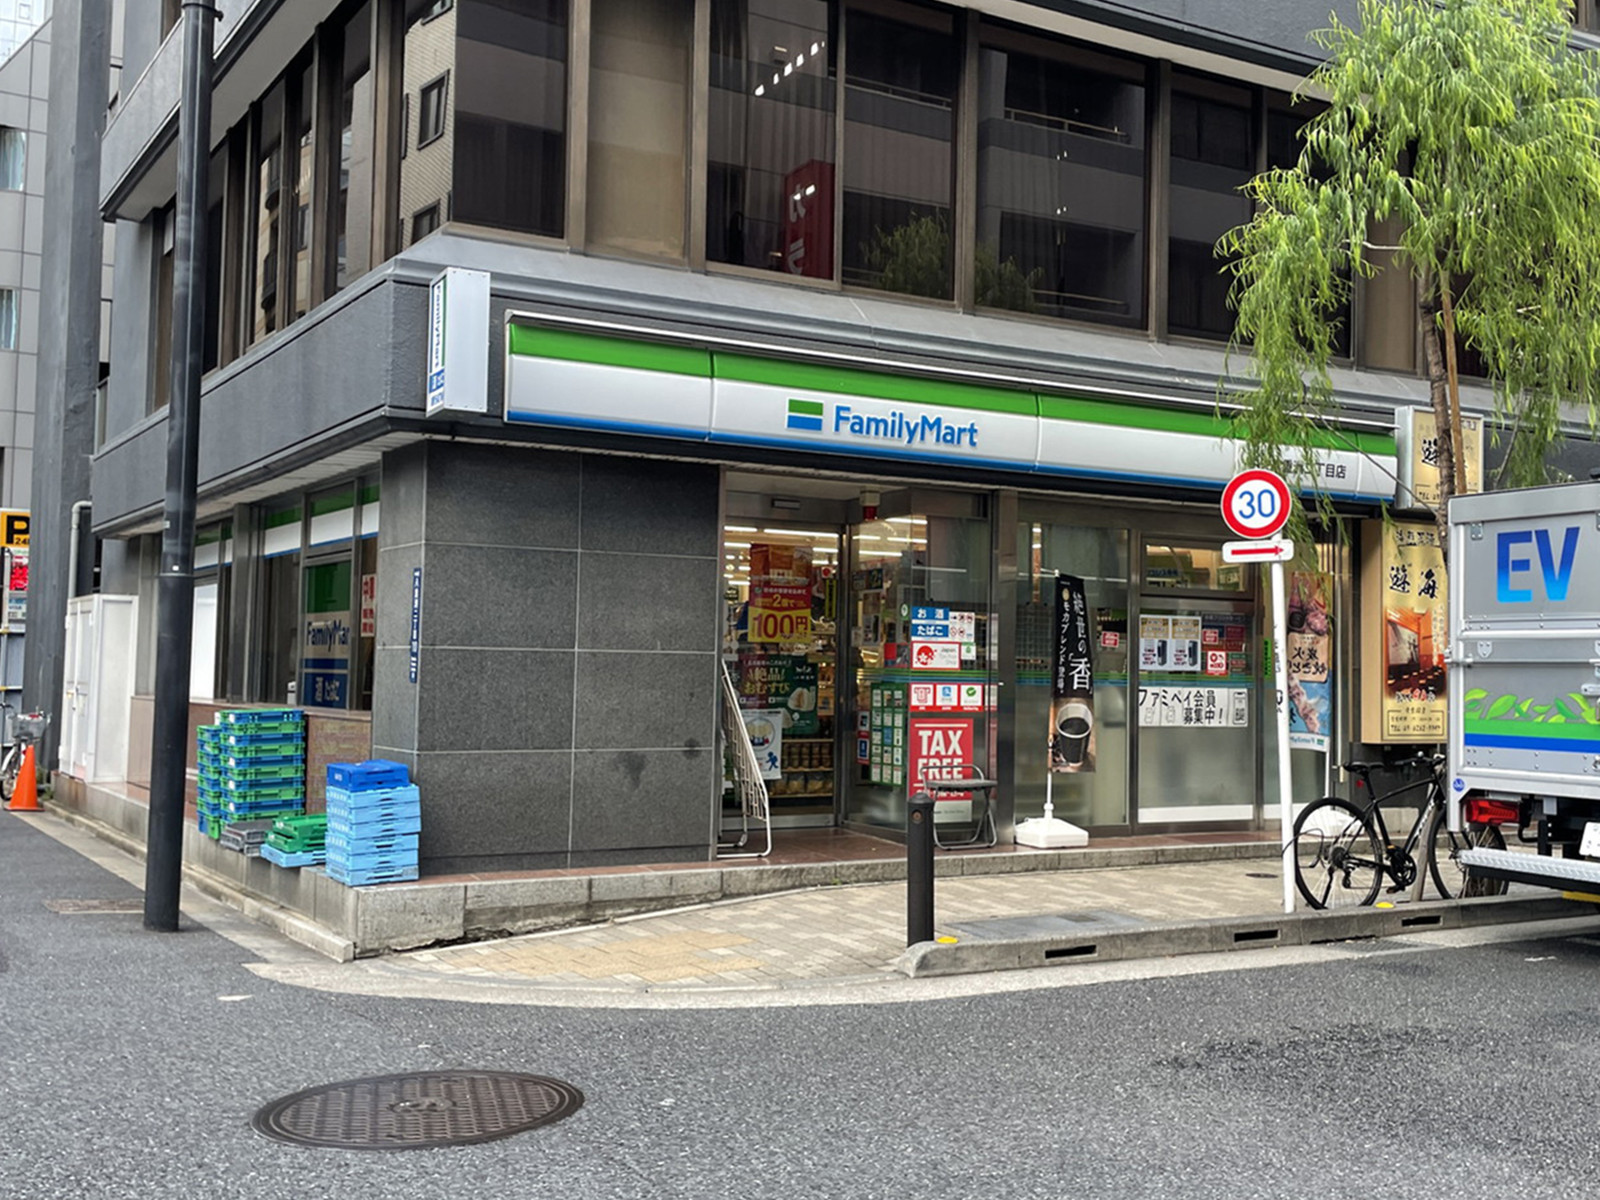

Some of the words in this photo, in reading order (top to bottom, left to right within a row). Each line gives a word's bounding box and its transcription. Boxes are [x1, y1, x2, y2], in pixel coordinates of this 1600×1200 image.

[834, 404, 979, 447] FamilyMart
[1239, 488, 1275, 520] 30
[6, 514, 30, 545] P
[1496, 526, 1581, 604] EV
[307, 619, 349, 653] FamilyMar
[753, 613, 809, 639] 100円
[917, 625, 944, 636] たばこ
[918, 730, 963, 756] TAX
[917, 758, 964, 780] FREE
